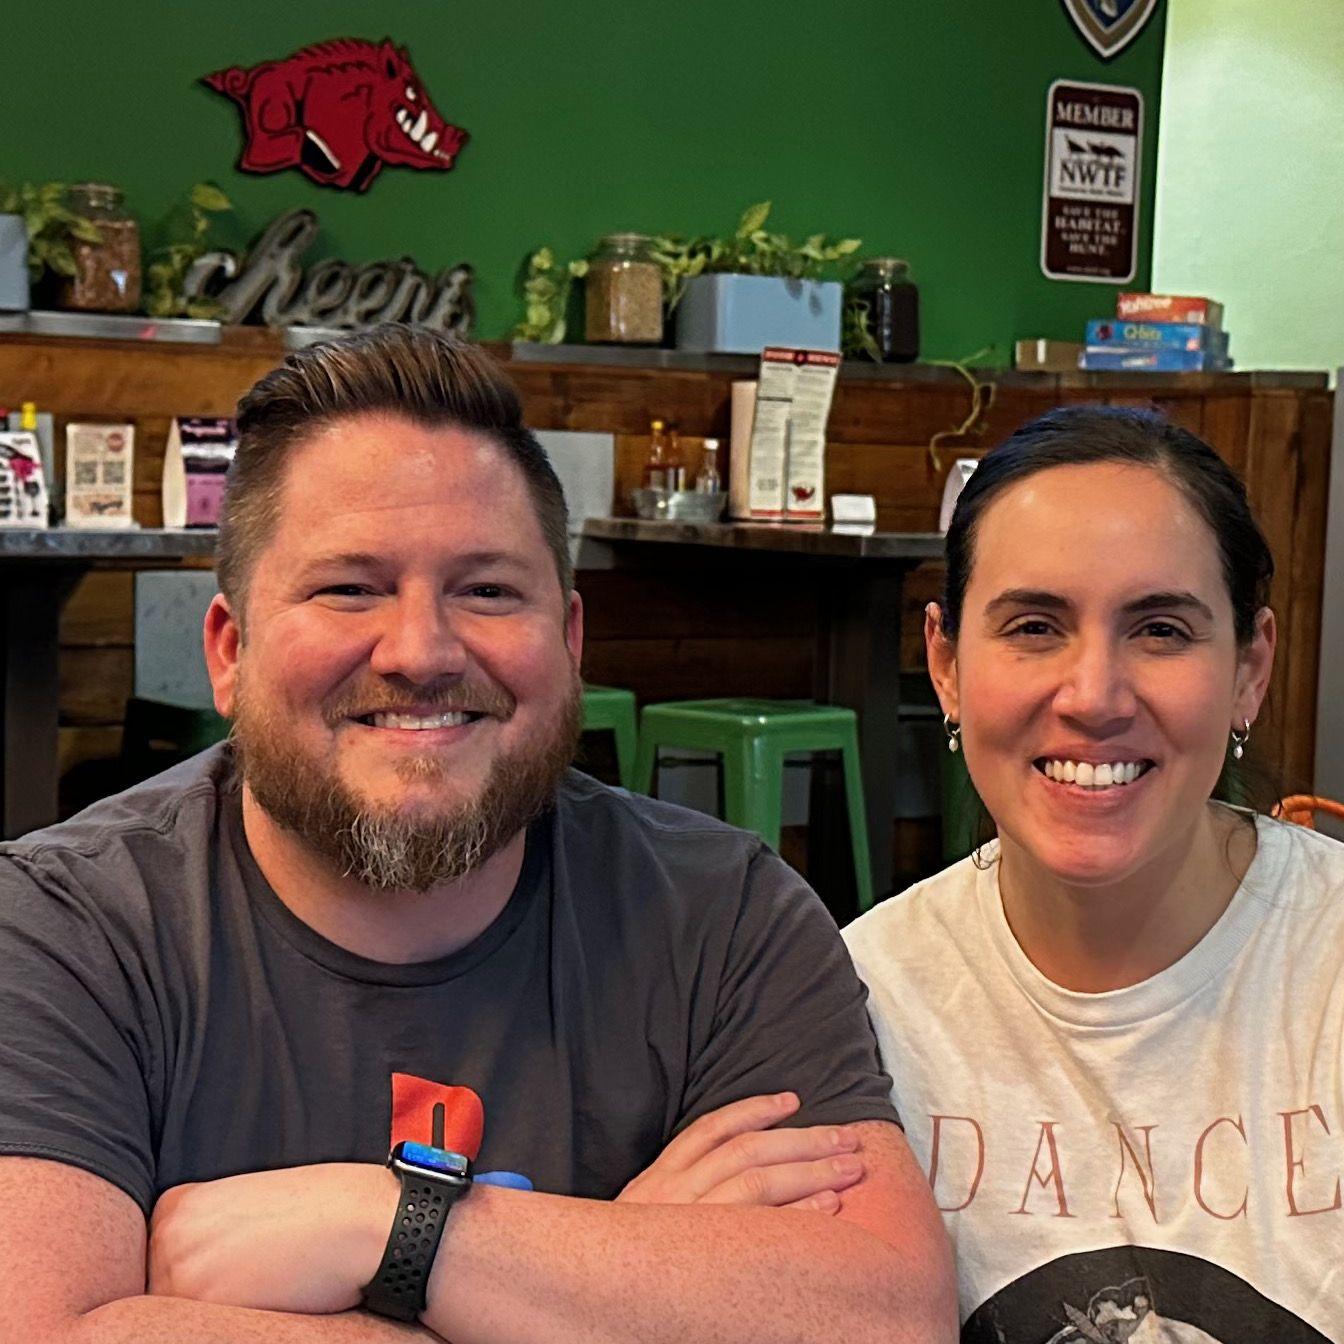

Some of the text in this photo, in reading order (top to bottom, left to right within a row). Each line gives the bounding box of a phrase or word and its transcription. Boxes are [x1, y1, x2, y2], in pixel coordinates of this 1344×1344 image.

[1056, 102, 1134, 130] MEMBER
[1060, 162, 1127, 189] NWTF
[1062, 205, 1119, 220] SAVE THE
[1060, 231, 1118, 246] SAVE THE
[930, 1103, 1343, 1223] DANCE
